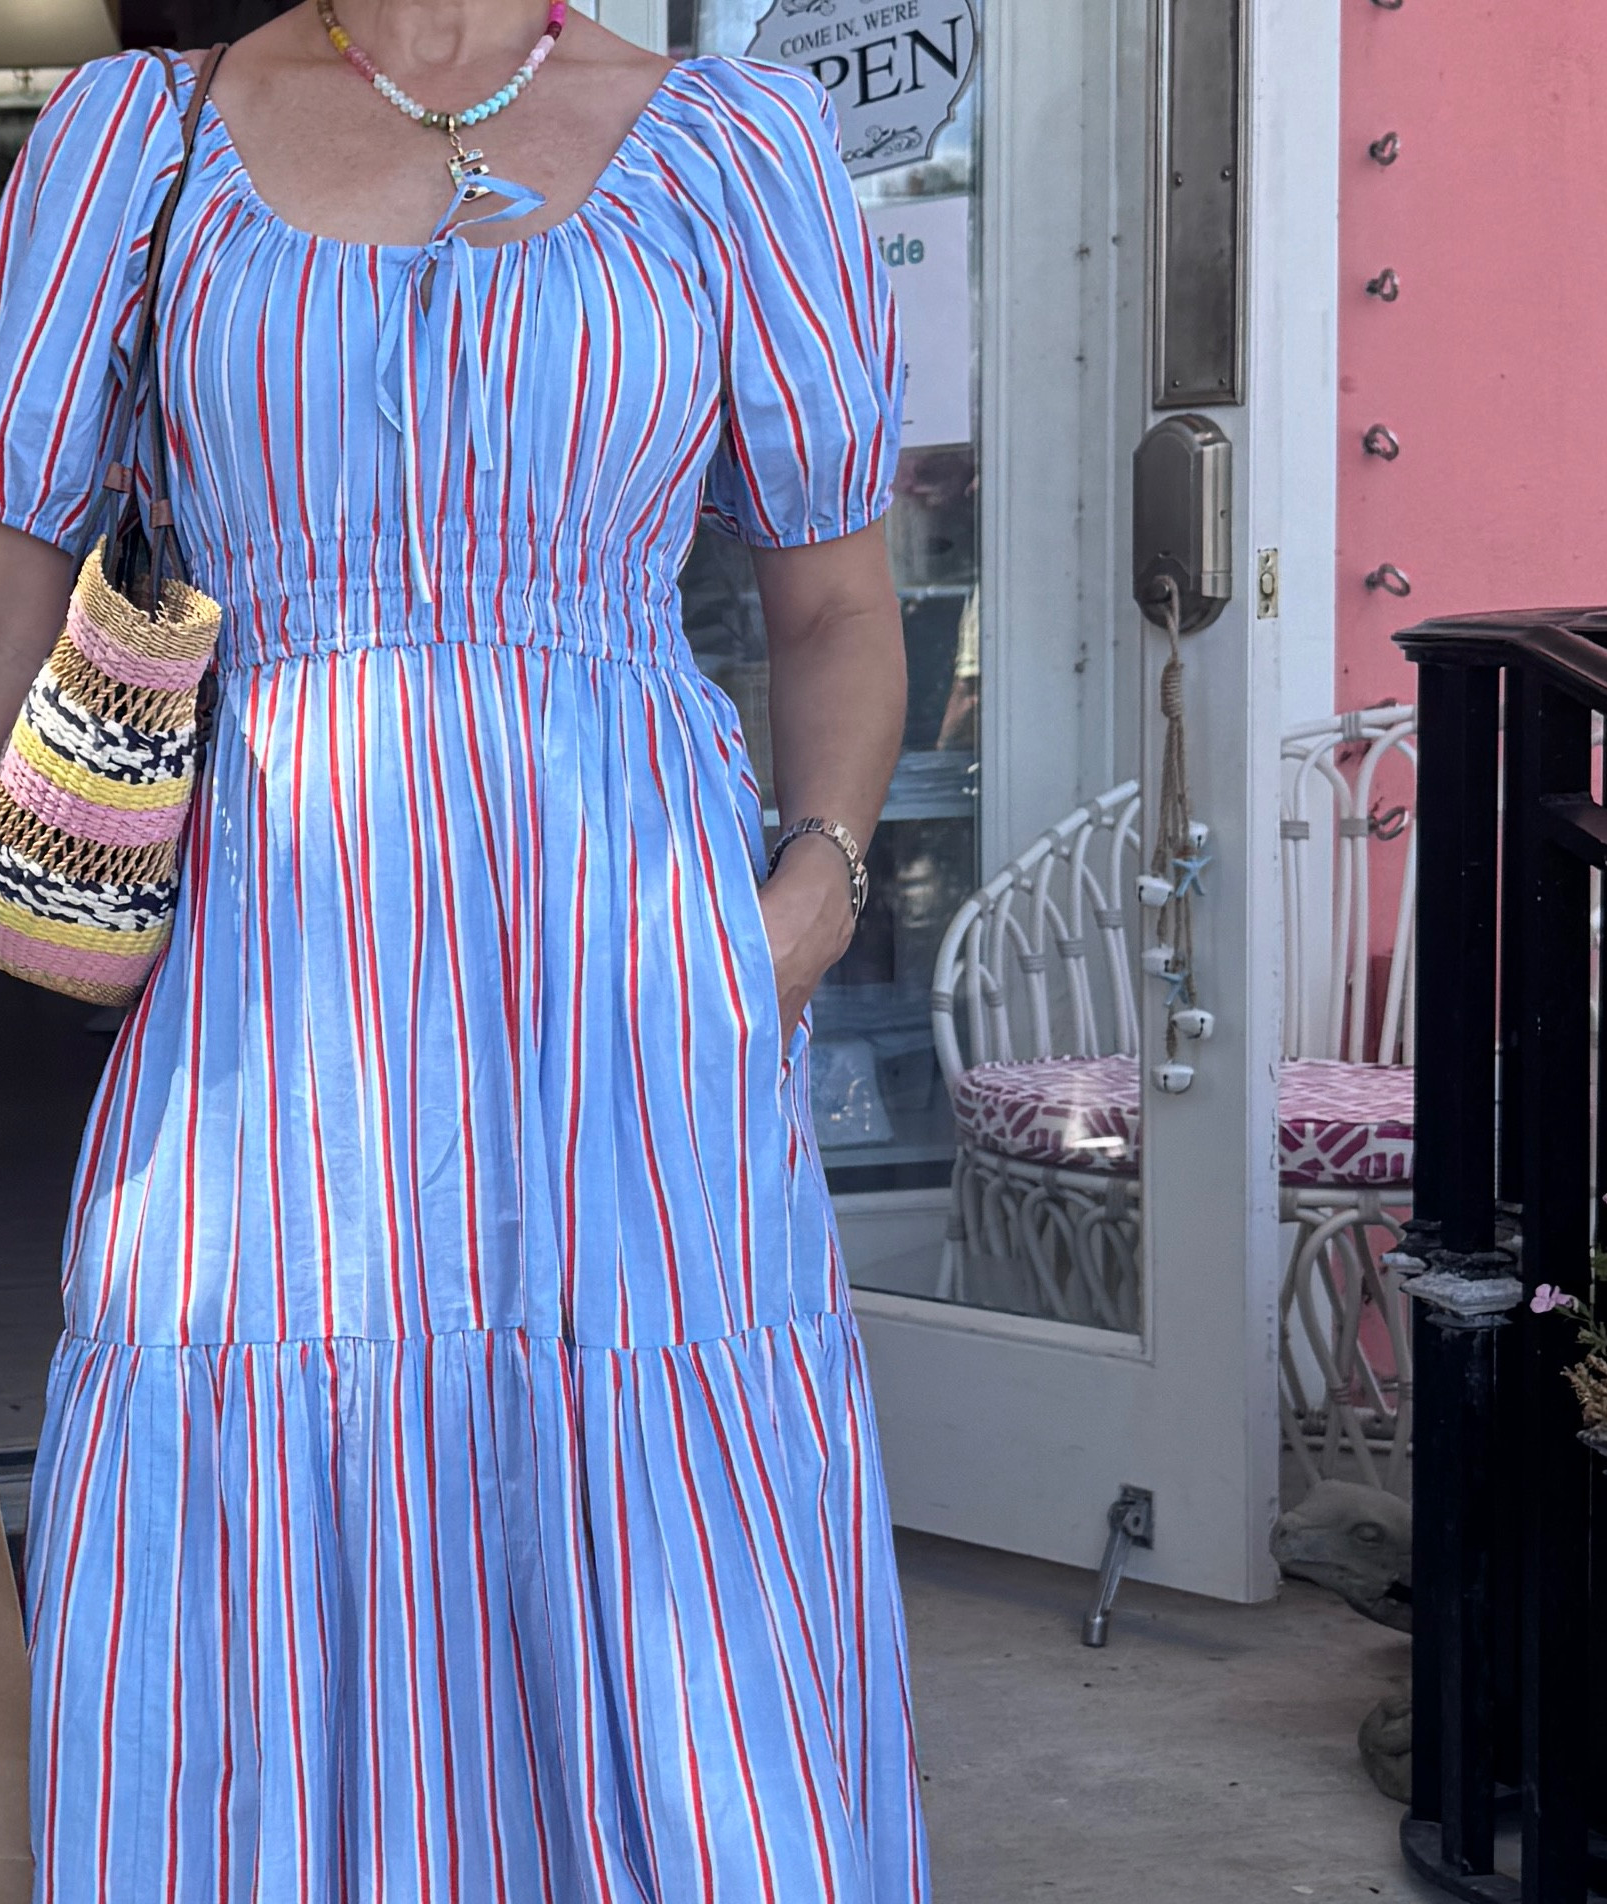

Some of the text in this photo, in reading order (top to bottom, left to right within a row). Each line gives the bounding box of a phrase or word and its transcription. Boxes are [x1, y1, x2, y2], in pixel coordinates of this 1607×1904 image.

[780, 27, 832, 59] COME
[804, 14, 964, 109] PEN
[878, 233, 925, 267] ide
